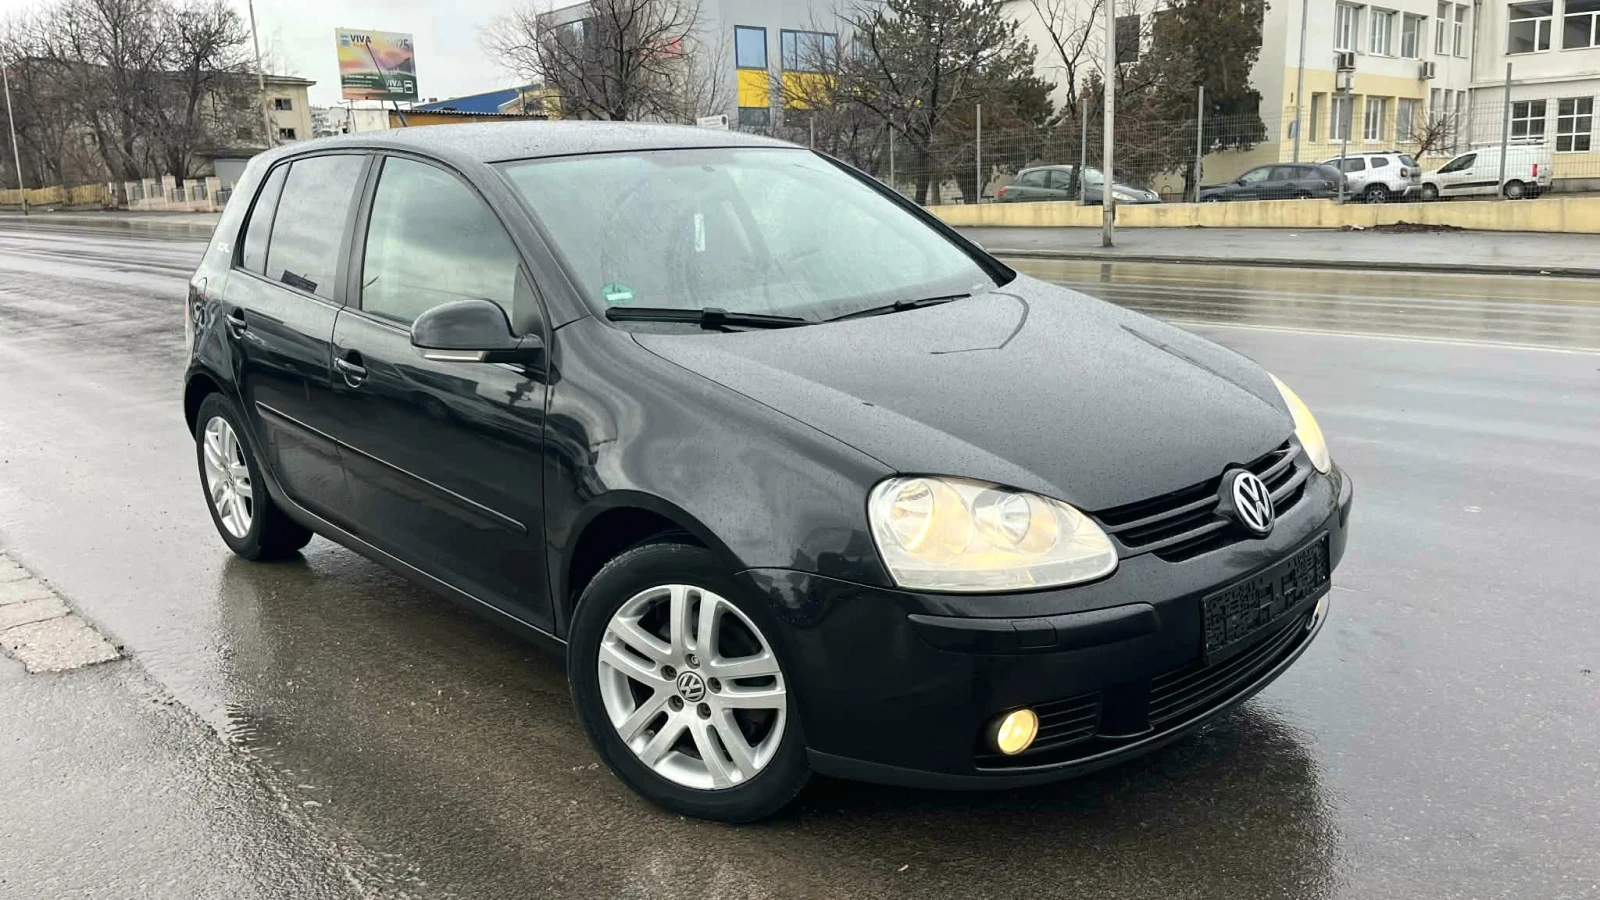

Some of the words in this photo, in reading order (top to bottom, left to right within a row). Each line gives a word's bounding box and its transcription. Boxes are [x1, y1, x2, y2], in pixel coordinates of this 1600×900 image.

[350, 34, 371, 44] VIVA
[386, 79, 402, 87] VIVA
[1234, 473, 1273, 531] VW
[678, 671, 705, 702] VW
